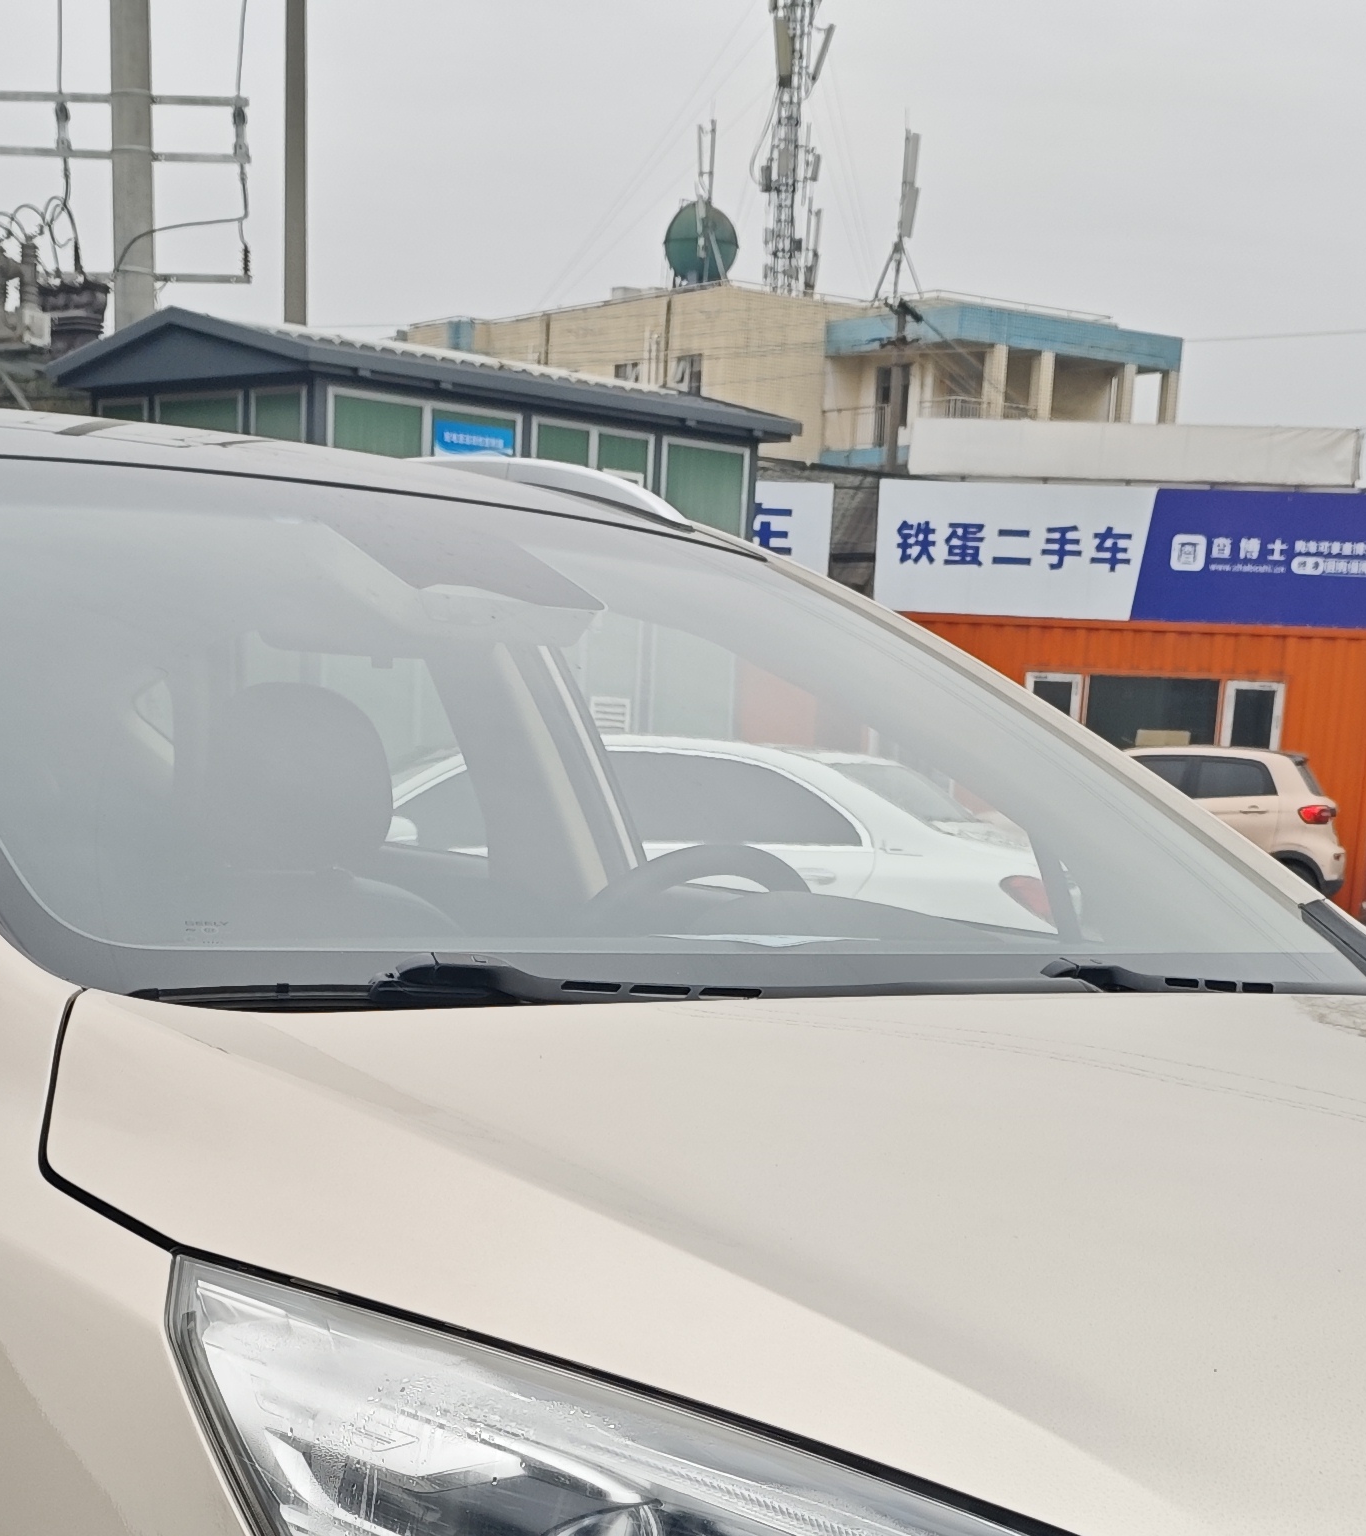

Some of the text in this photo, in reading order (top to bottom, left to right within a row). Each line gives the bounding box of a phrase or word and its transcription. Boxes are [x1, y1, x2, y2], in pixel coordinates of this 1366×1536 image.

[896, 519, 1133, 573] 铁蛋二手车
